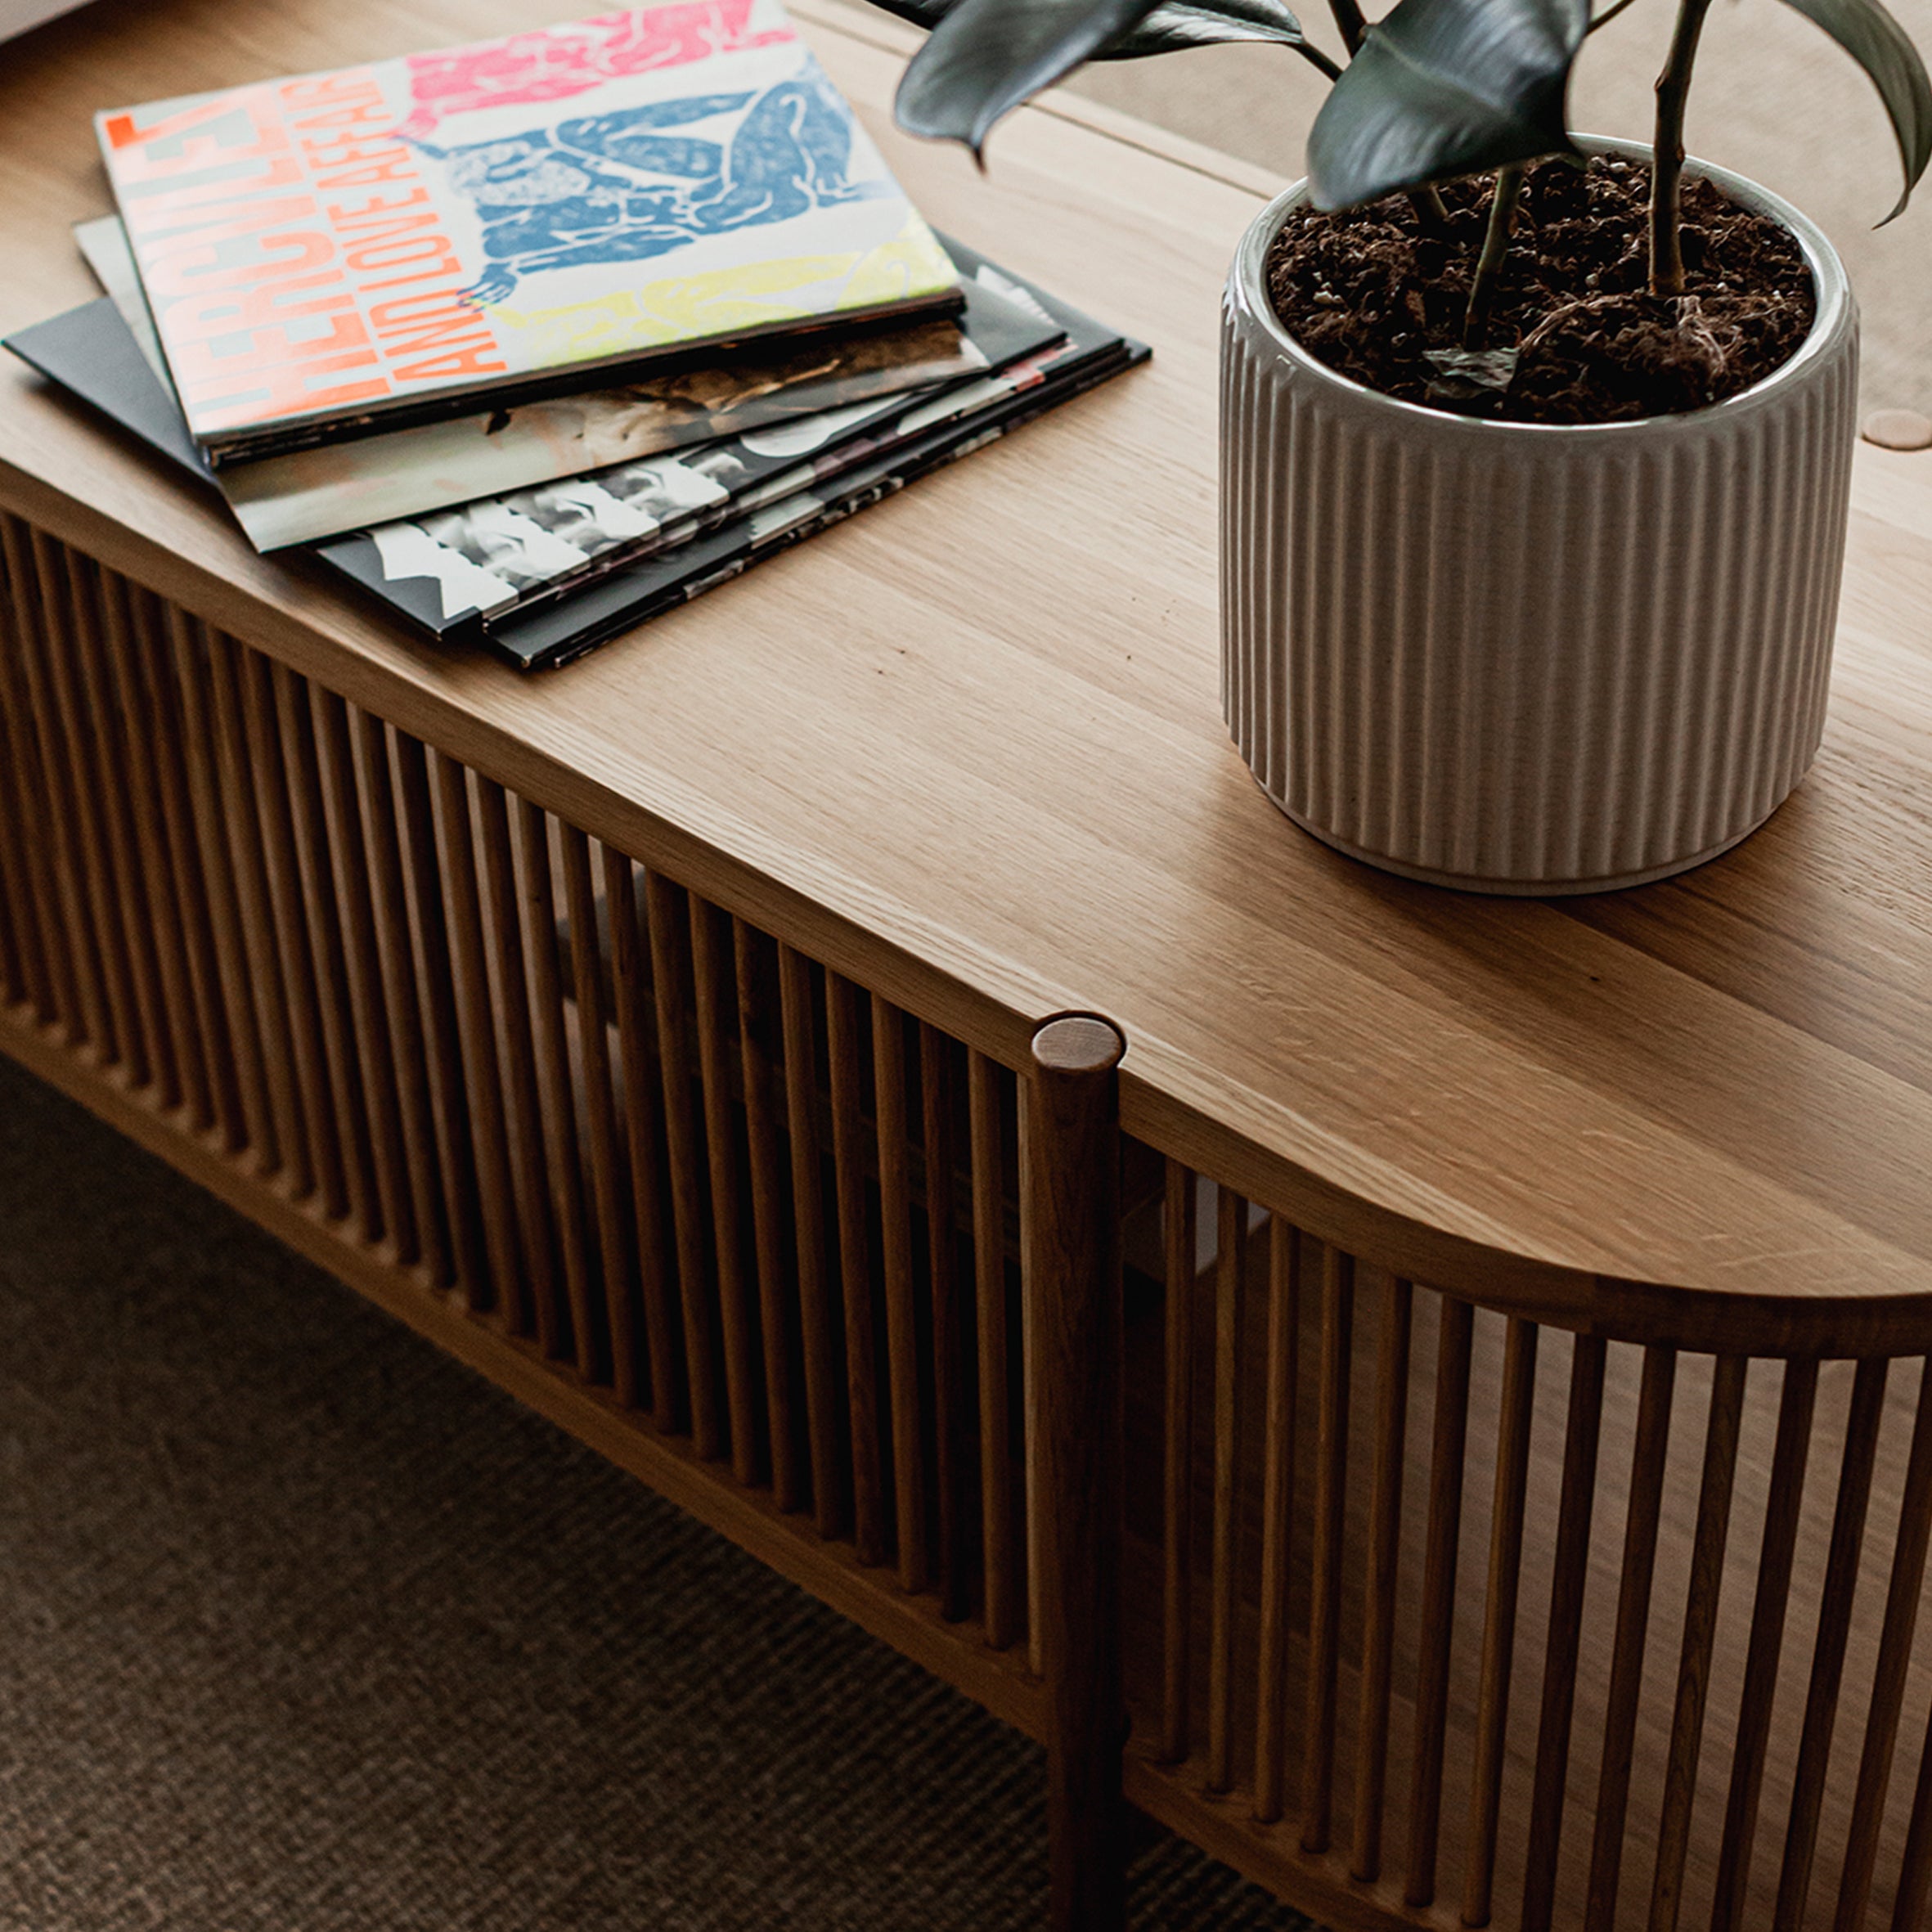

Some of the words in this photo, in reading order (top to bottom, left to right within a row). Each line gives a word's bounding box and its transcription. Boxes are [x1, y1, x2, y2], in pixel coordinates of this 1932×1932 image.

[281, 69, 418, 188] AFFAIR
[328, 187, 461, 292] LOVE
[370, 288, 507, 381] AND
